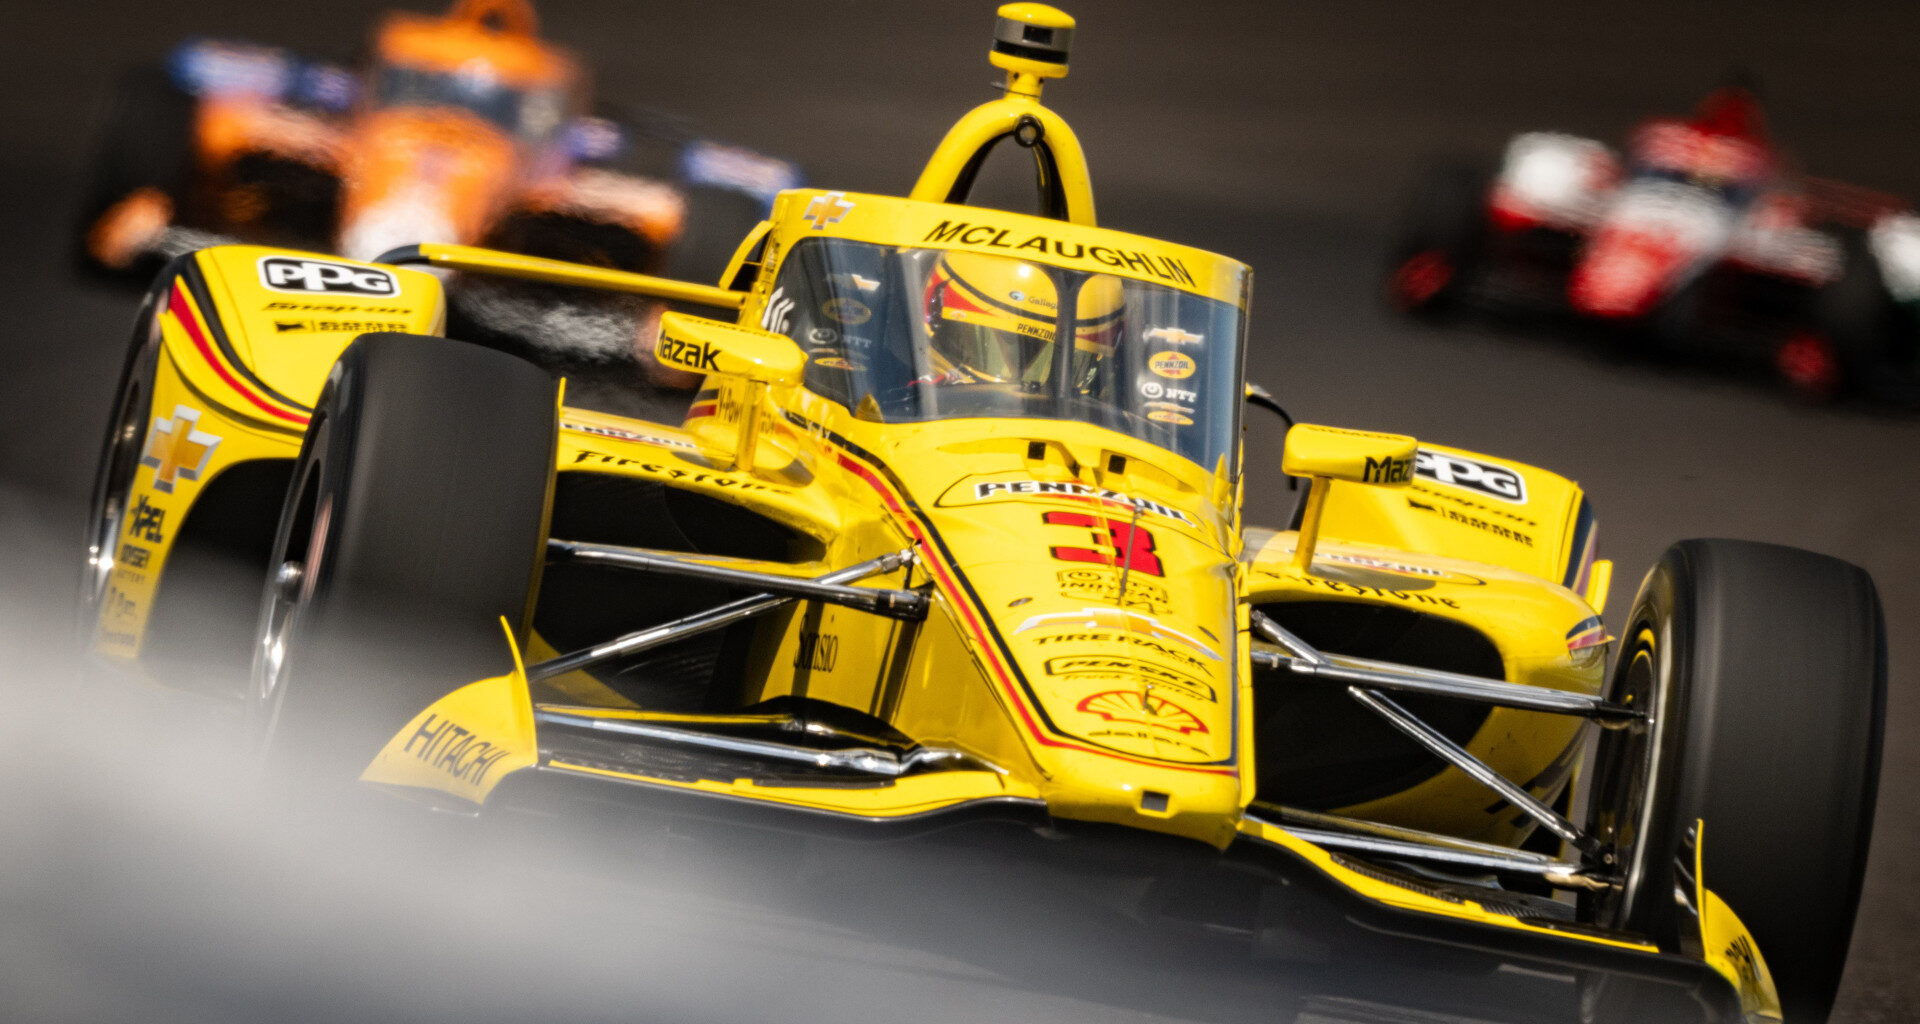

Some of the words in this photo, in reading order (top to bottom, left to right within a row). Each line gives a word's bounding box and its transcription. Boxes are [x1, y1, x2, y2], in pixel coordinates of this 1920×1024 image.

[923, 220, 1196, 288] MCLAUGHLIN
[266, 262, 392, 291] PPG
[1028, 296, 1057, 309] Gallag
[1154, 361, 1190, 370] PENNZOIL
[1166, 387, 1197, 403] NTT
[574, 450, 794, 495] Firestone
[1363, 456, 1416, 483] Maz
[975, 480, 1197, 528] PENNZOIL
[1042, 511, 1165, 577] 3
[1033, 634, 1111, 646] TIRE
[1117, 636, 1215, 679] RACK
[1062, 660, 1199, 687] PENSKE
[403, 713, 511, 786] HITACHI
